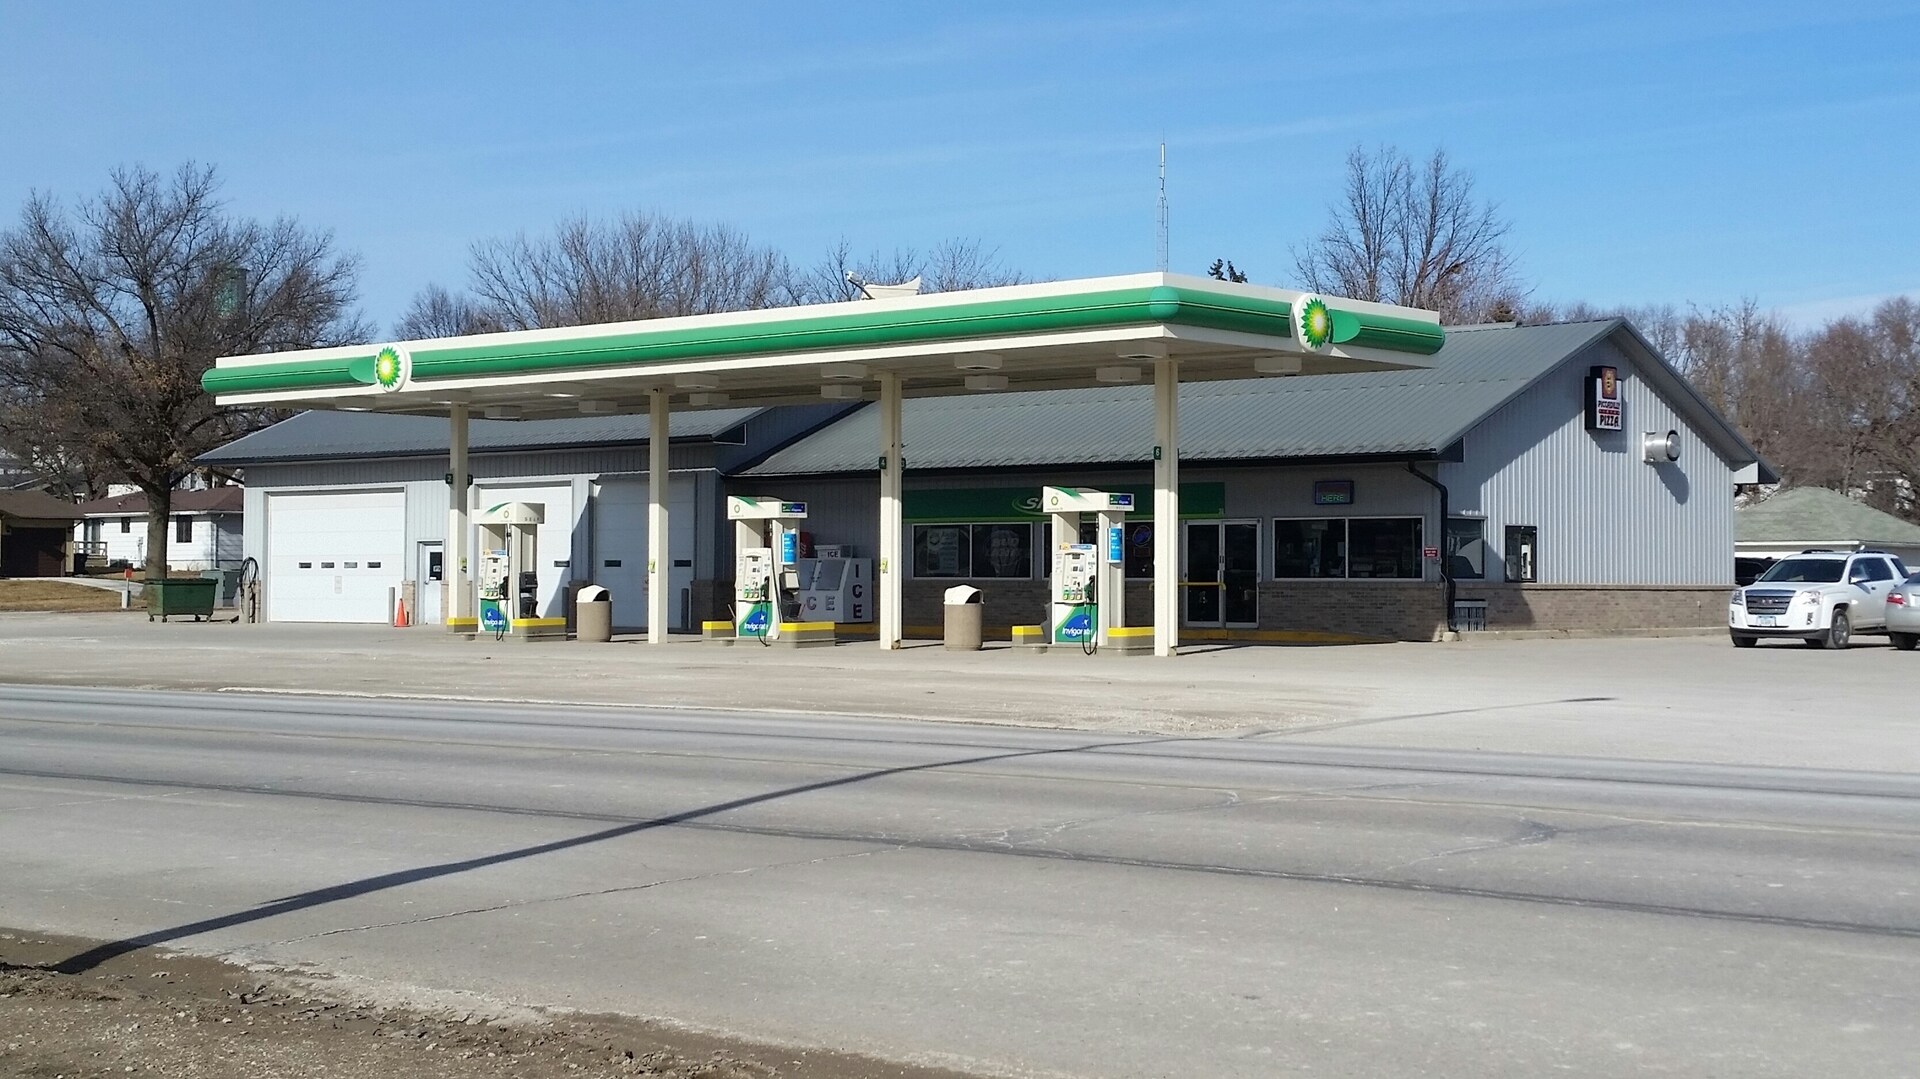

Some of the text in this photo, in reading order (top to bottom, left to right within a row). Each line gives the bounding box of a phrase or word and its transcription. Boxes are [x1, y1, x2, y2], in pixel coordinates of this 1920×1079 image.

[1599, 415, 1619, 427] PIZZA
[1321, 494, 1344, 502] HERE
[852, 564, 863, 618] ICE
[806, 596, 835, 611] CE
